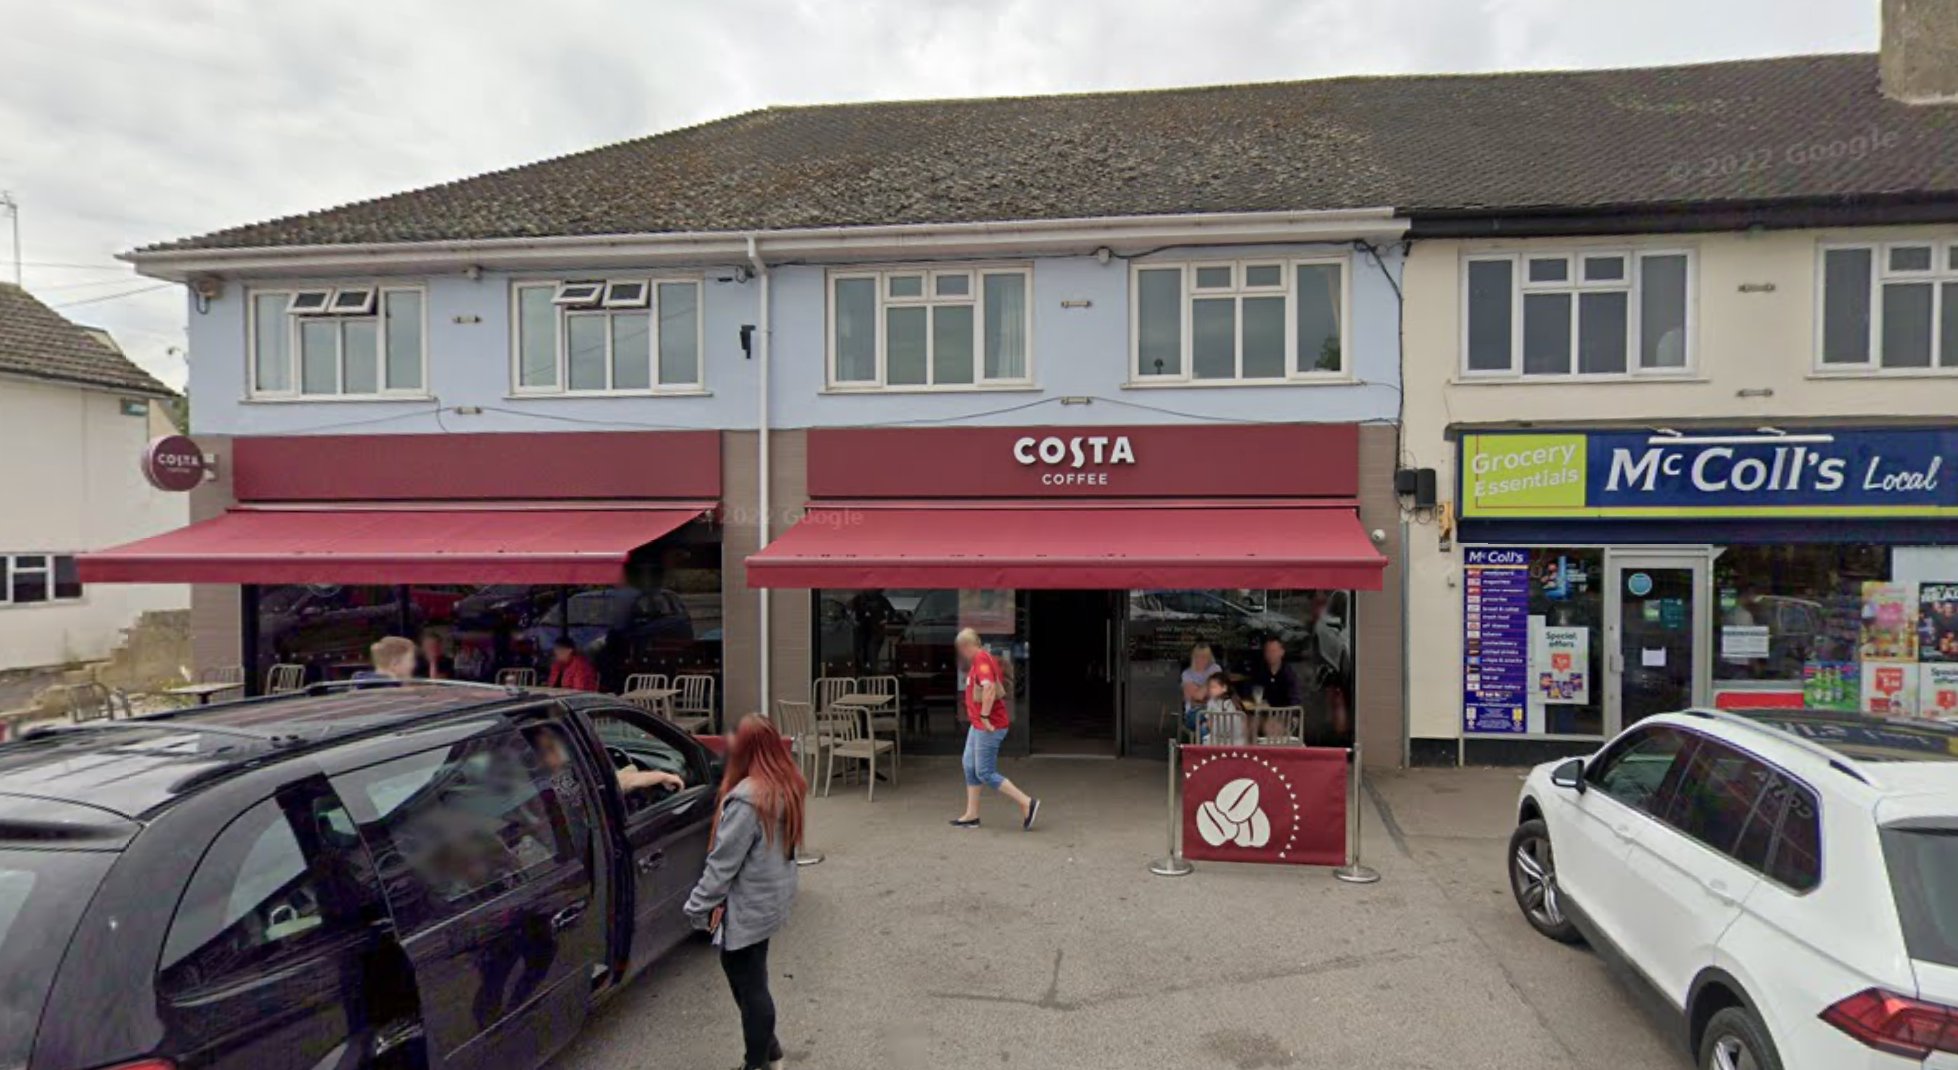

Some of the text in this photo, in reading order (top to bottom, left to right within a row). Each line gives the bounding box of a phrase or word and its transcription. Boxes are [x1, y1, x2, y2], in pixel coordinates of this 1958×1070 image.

[158, 454, 199, 466] COSTA
[1013, 436, 1135, 468] COSTA
[1471, 443, 1577, 474] Grocery
[1041, 473, 1108, 485] COFFEE
[1474, 467, 1580, 497] Essentials
[1862, 456, 1943, 491] Local
[1545, 631, 1577, 641] Special
